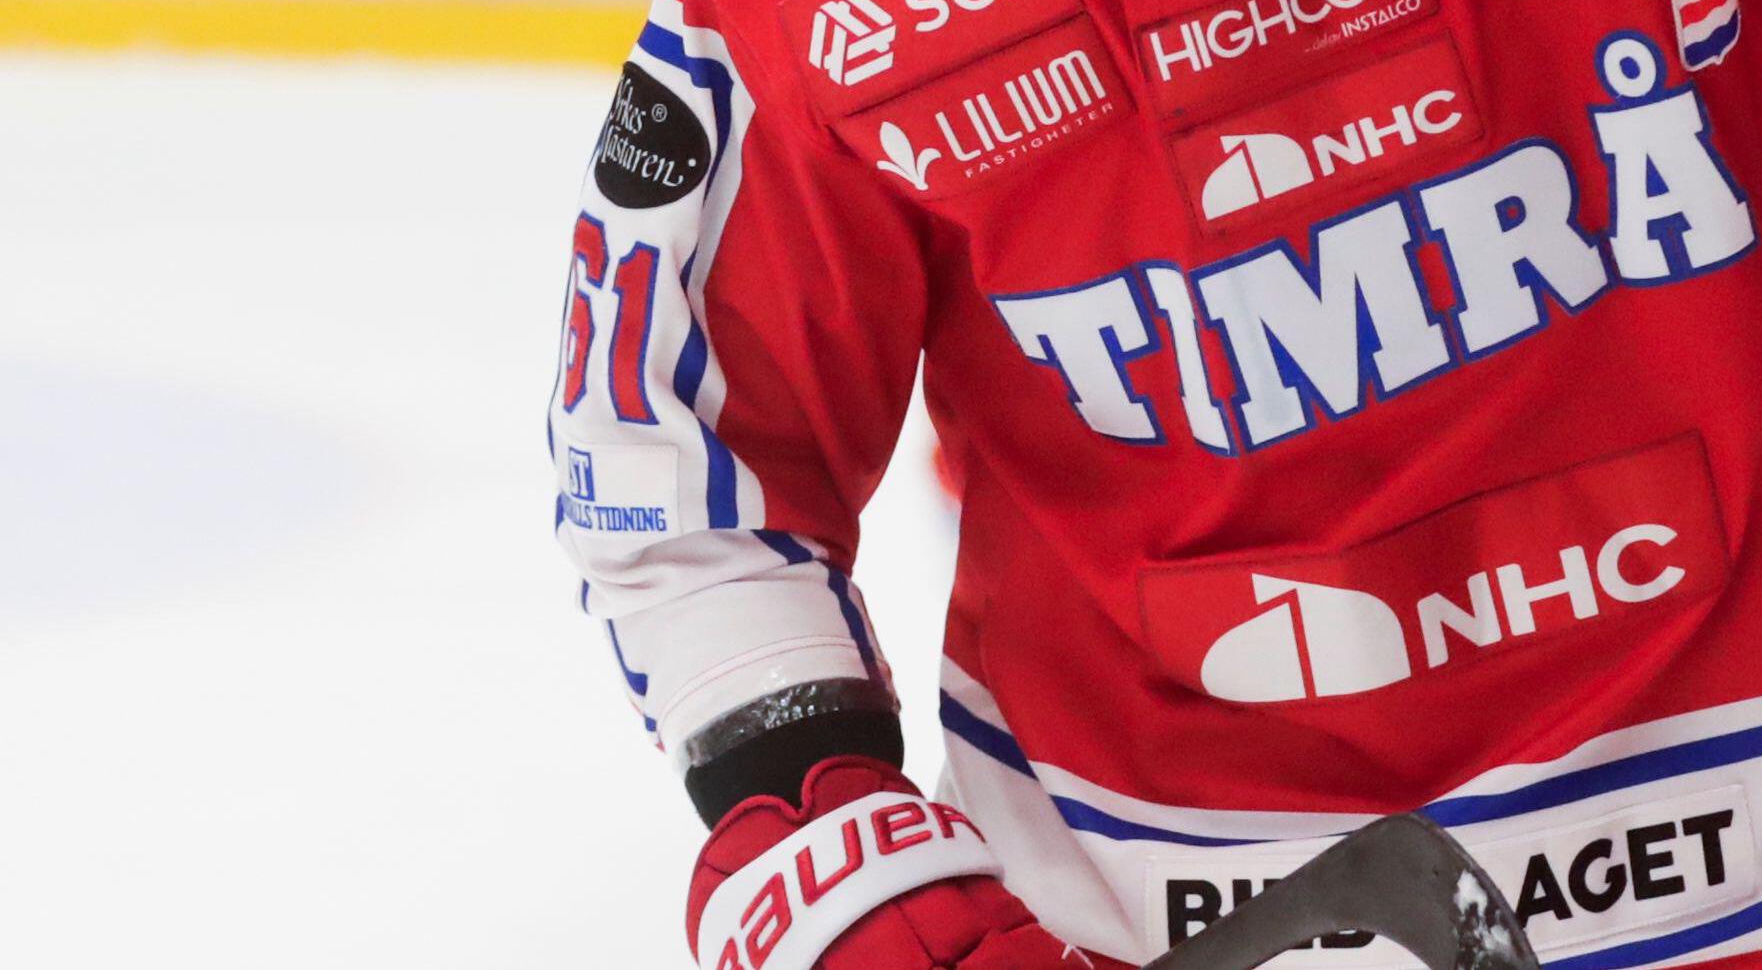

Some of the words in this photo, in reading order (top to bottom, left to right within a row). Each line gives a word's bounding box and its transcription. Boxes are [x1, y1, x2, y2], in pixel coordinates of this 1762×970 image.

[935, 49, 1107, 162] LILIUM
[965, 101, 1114, 179] FASTIGHETER
[1312, 88, 1463, 178] NHC
[989, 32, 1759, 459] TIMRÅ
[563, 210, 660, 426] 61
[593, 505, 667, 532] TIDNING
[1416, 523, 1687, 670] NHC
